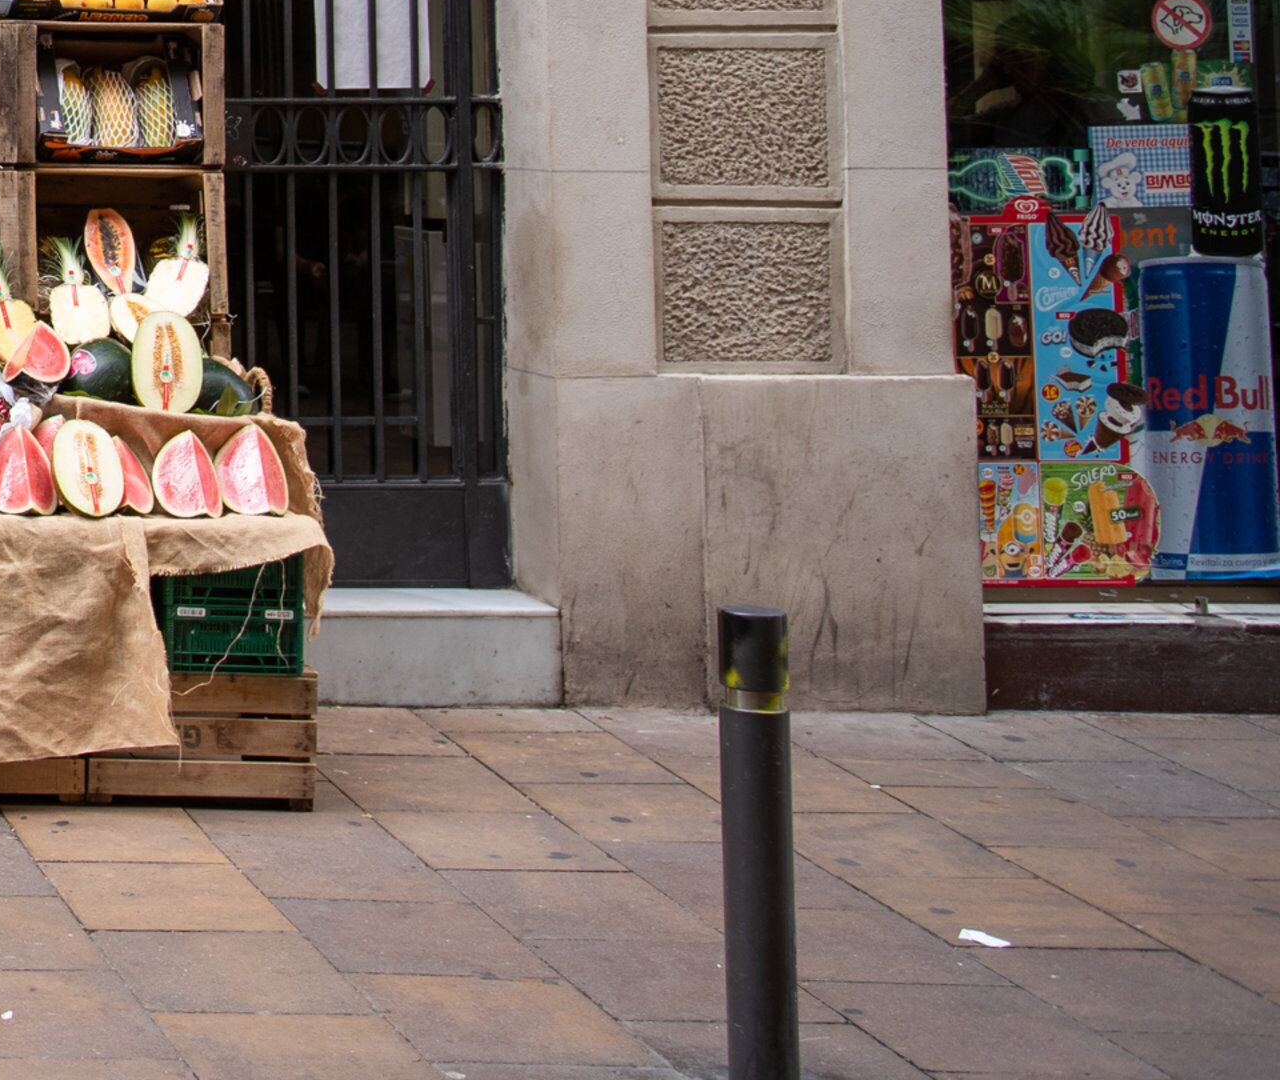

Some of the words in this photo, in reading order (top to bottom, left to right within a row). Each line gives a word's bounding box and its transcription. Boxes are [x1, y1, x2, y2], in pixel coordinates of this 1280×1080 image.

[79, 11, 149, 22] LEONCIO
[1106, 137, 1121, 148] De
[1124, 138, 1157, 148] venta
[1193, 210, 1262, 228] MONSTER
[1200, 228, 1256, 237] ENERGY
[1147, 373, 1208, 411] Red
[1214, 376, 1270, 410] Bull
[1152, 450, 1214, 465] ENERGY
[1070, 464, 1117, 491] SOLERO
[1111, 511, 1127, 521] 50
